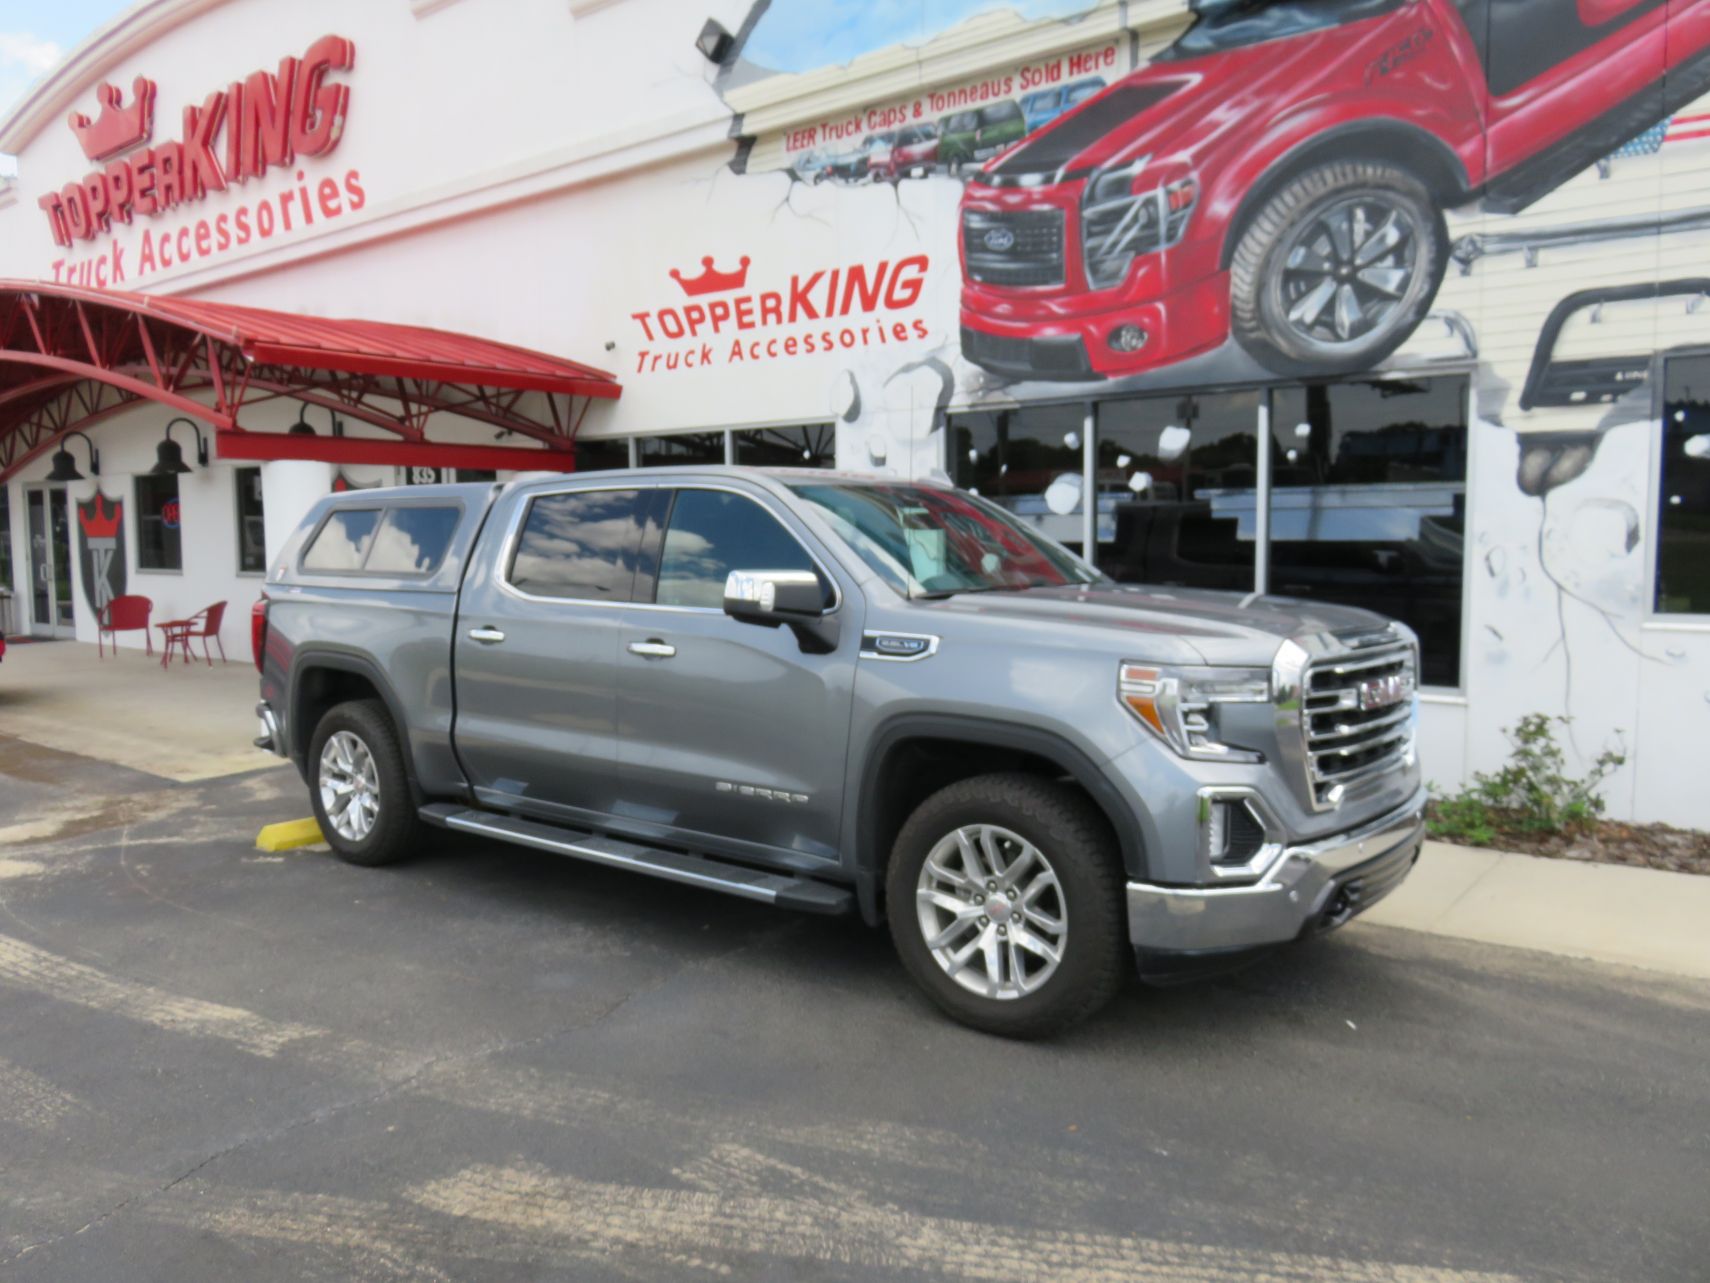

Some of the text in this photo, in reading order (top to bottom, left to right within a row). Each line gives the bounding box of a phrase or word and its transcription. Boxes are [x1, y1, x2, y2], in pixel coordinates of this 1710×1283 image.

[38, 33, 355, 248] TOPPERKING
[785, 44, 1117, 153] LEER Truck Caps & Tonneaus Sold Here
[51, 168, 367, 289] Truck Accessories
[630, 253, 930, 343] TOPPERKING
[636, 317, 930, 374] Truck Accessories
[411, 465, 436, 485] 835
